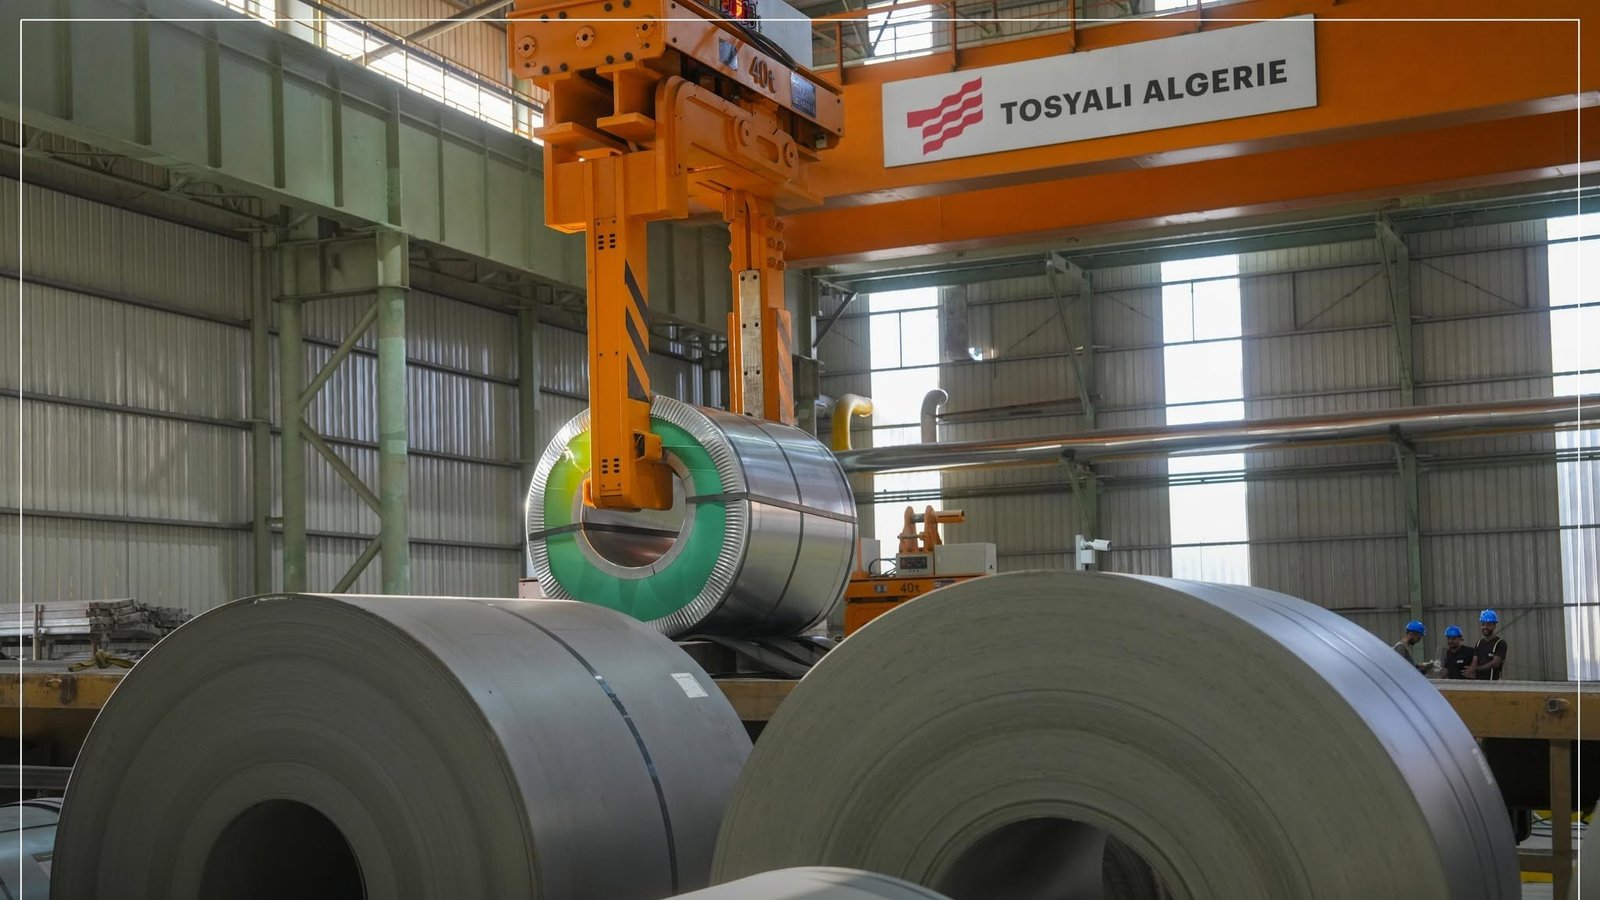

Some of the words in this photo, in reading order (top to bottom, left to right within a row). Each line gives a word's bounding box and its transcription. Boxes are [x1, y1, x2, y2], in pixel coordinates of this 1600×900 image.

[749, 56, 776, 94] 40t
[1000, 83, 1132, 125] TOSYALI
[1143, 59, 1288, 105] ALGERIE
[900, 582, 921, 593] 40t
